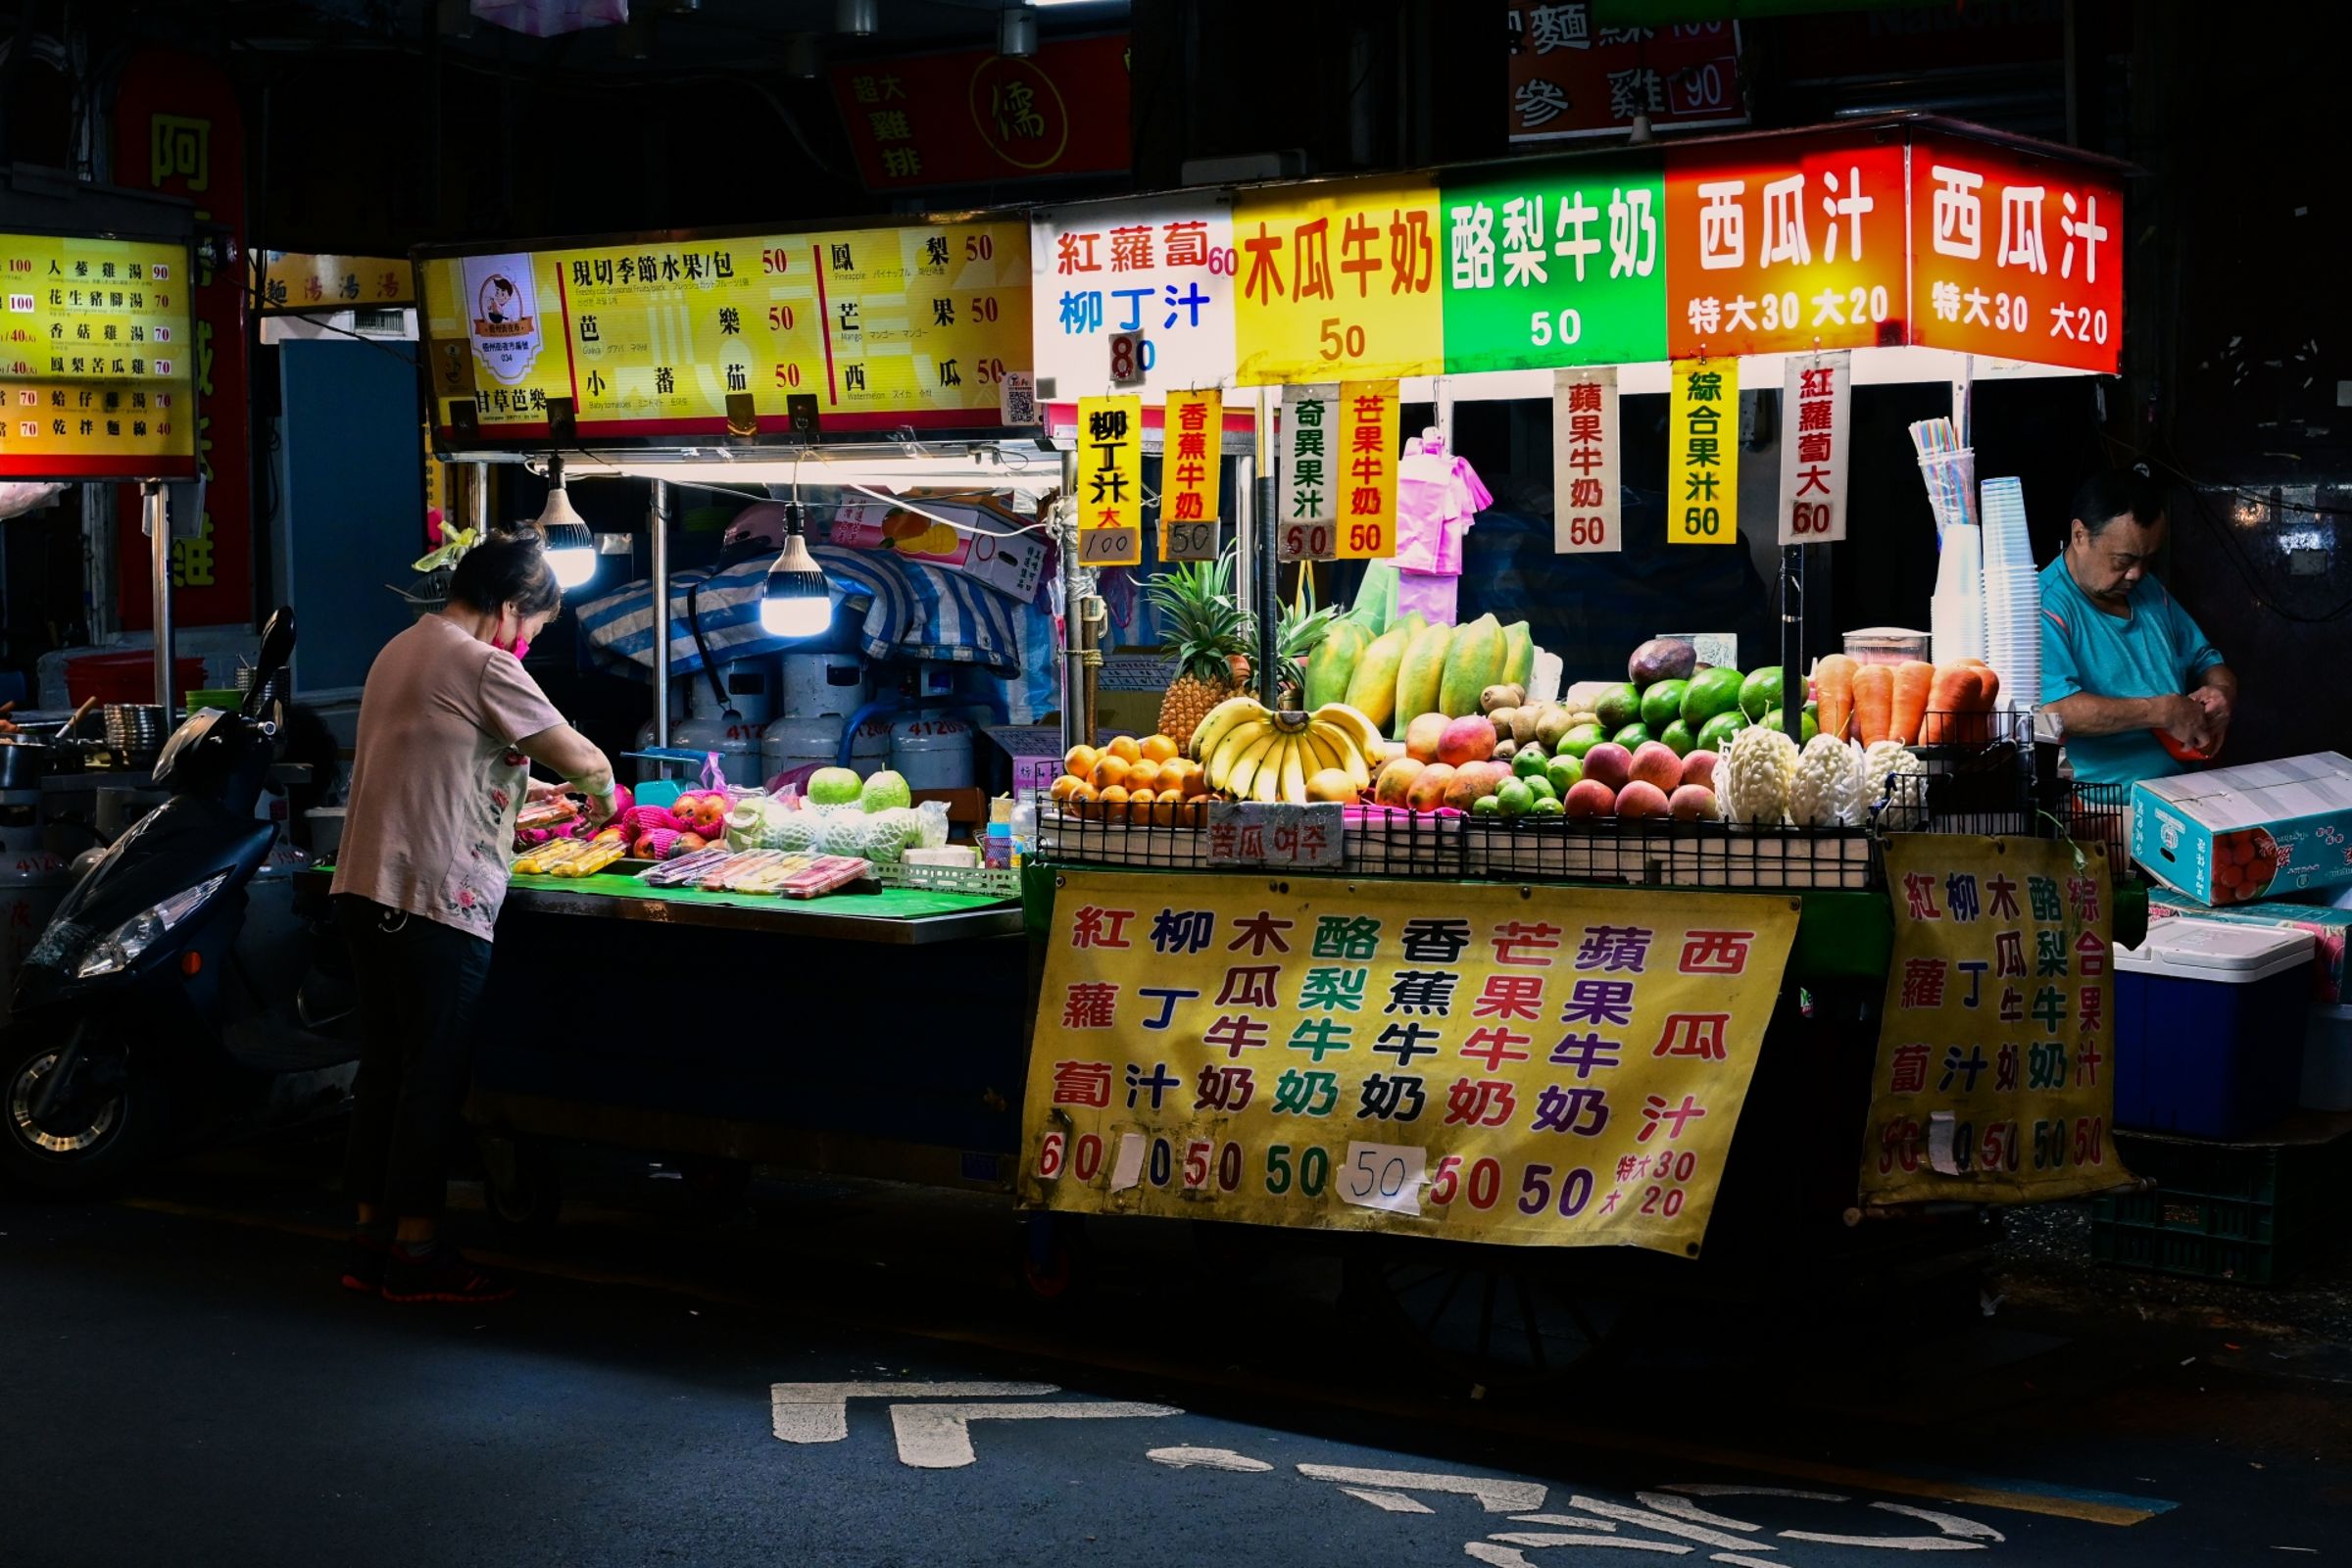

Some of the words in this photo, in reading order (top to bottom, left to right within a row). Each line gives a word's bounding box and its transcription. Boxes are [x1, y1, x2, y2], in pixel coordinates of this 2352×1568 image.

[1685, 63, 1723, 107] 90
[1450, 188, 1656, 291] 酪梨牛奶
[1697, 166, 1874, 270] 西瓜汁
[1932, 165, 2108, 284] 西瓜汁
[10, 260, 31, 272] 100
[154, 266, 168, 279] 90
[573, 251, 734, 286] 現切季節水果/包
[762, 248, 788, 273] 50
[831, 236, 950, 270] 鳳梨
[965, 234, 993, 261] 50
[1057, 220, 1208, 275] 紅蘿蔔
[1208, 246, 1239, 276] 60
[1245, 208, 1433, 307] 木瓜牛奶
[11, 297, 33, 310] 100
[155, 295, 169, 308] 70
[580, 308, 741, 342] 芭樂
[769, 306, 794, 330] 50
[839, 298, 955, 330] 芒果
[971, 297, 998, 322] 50
[1059, 282, 1210, 334] 柳丁汁
[155, 328, 170, 341] 70
[1319, 317, 1366, 362] 50
[1530, 308, 1582, 347] 50
[156, 361, 171, 373] 70
[587, 364, 747, 397] 小蕃茄
[775, 364, 800, 388] 50
[845, 359, 961, 391] 西瓜
[977, 358, 1004, 384] 50
[1111, 336, 1156, 378] 80
[21, 392, 35, 405] 70
[157, 395, 171, 408] 70
[22, 423, 36, 436] 70
[157, 422, 171, 435] 40
[1568, 383, 1603, 509] 蘋果牛奶
[1685, 370, 1722, 502] 綜合果汁
[1175, 403, 1208, 518] 香蕉牛奶
[1294, 399, 1325, 518] 奇異果汁
[1350, 396, 1385, 515] 芒果牛奶
[1171, 523, 1209, 553] 50
[1287, 525, 1326, 555] 60
[1349, 524, 1382, 551] 50
[1569, 517, 1605, 546] 50
[1685, 507, 1720, 536] 50
[1792, 503, 1831, 534] 60
[1086, 534, 1127, 558] 100
[1210, 823, 1266, 859] 苦瓜
[1275, 822, 1328, 862] 여주
[1889, 872, 1948, 1093] 紅蘿蔔
[1938, 871, 1988, 1093] 柳丁汁
[2028, 876, 2068, 1089] 酪梨牛奶
[2066, 876, 2106, 1088] 綜合果汁
[1053, 906, 1136, 1110] 紅蘿蔔
[1125, 907, 1214, 1110] 柳丁汁
[1194, 910, 1294, 1114] 木瓜牛奶
[1271, 913, 1383, 1118] 酪梨牛奶
[1356, 917, 1473, 1124] 香蕉牛奶
[1444, 921, 1565, 1128] 芒果牛奶
[1530, 924, 1654, 1137] 蘋果牛奶
[1639, 929, 1756, 1143] 西瓜汁
[1040, 1134, 1103, 1183] 60
[1184, 1142, 1243, 1193] 50
[1265, 1145, 1329, 1198] 50
[2034, 1119, 2066, 1169] 50
[2074, 1117, 2102, 1166] 50
[1350, 1151, 1406, 1198] 50
[1431, 1156, 1501, 1210] 50
[1519, 1164, 1594, 1218] 50
[1641, 1185, 1685, 1217] 20
